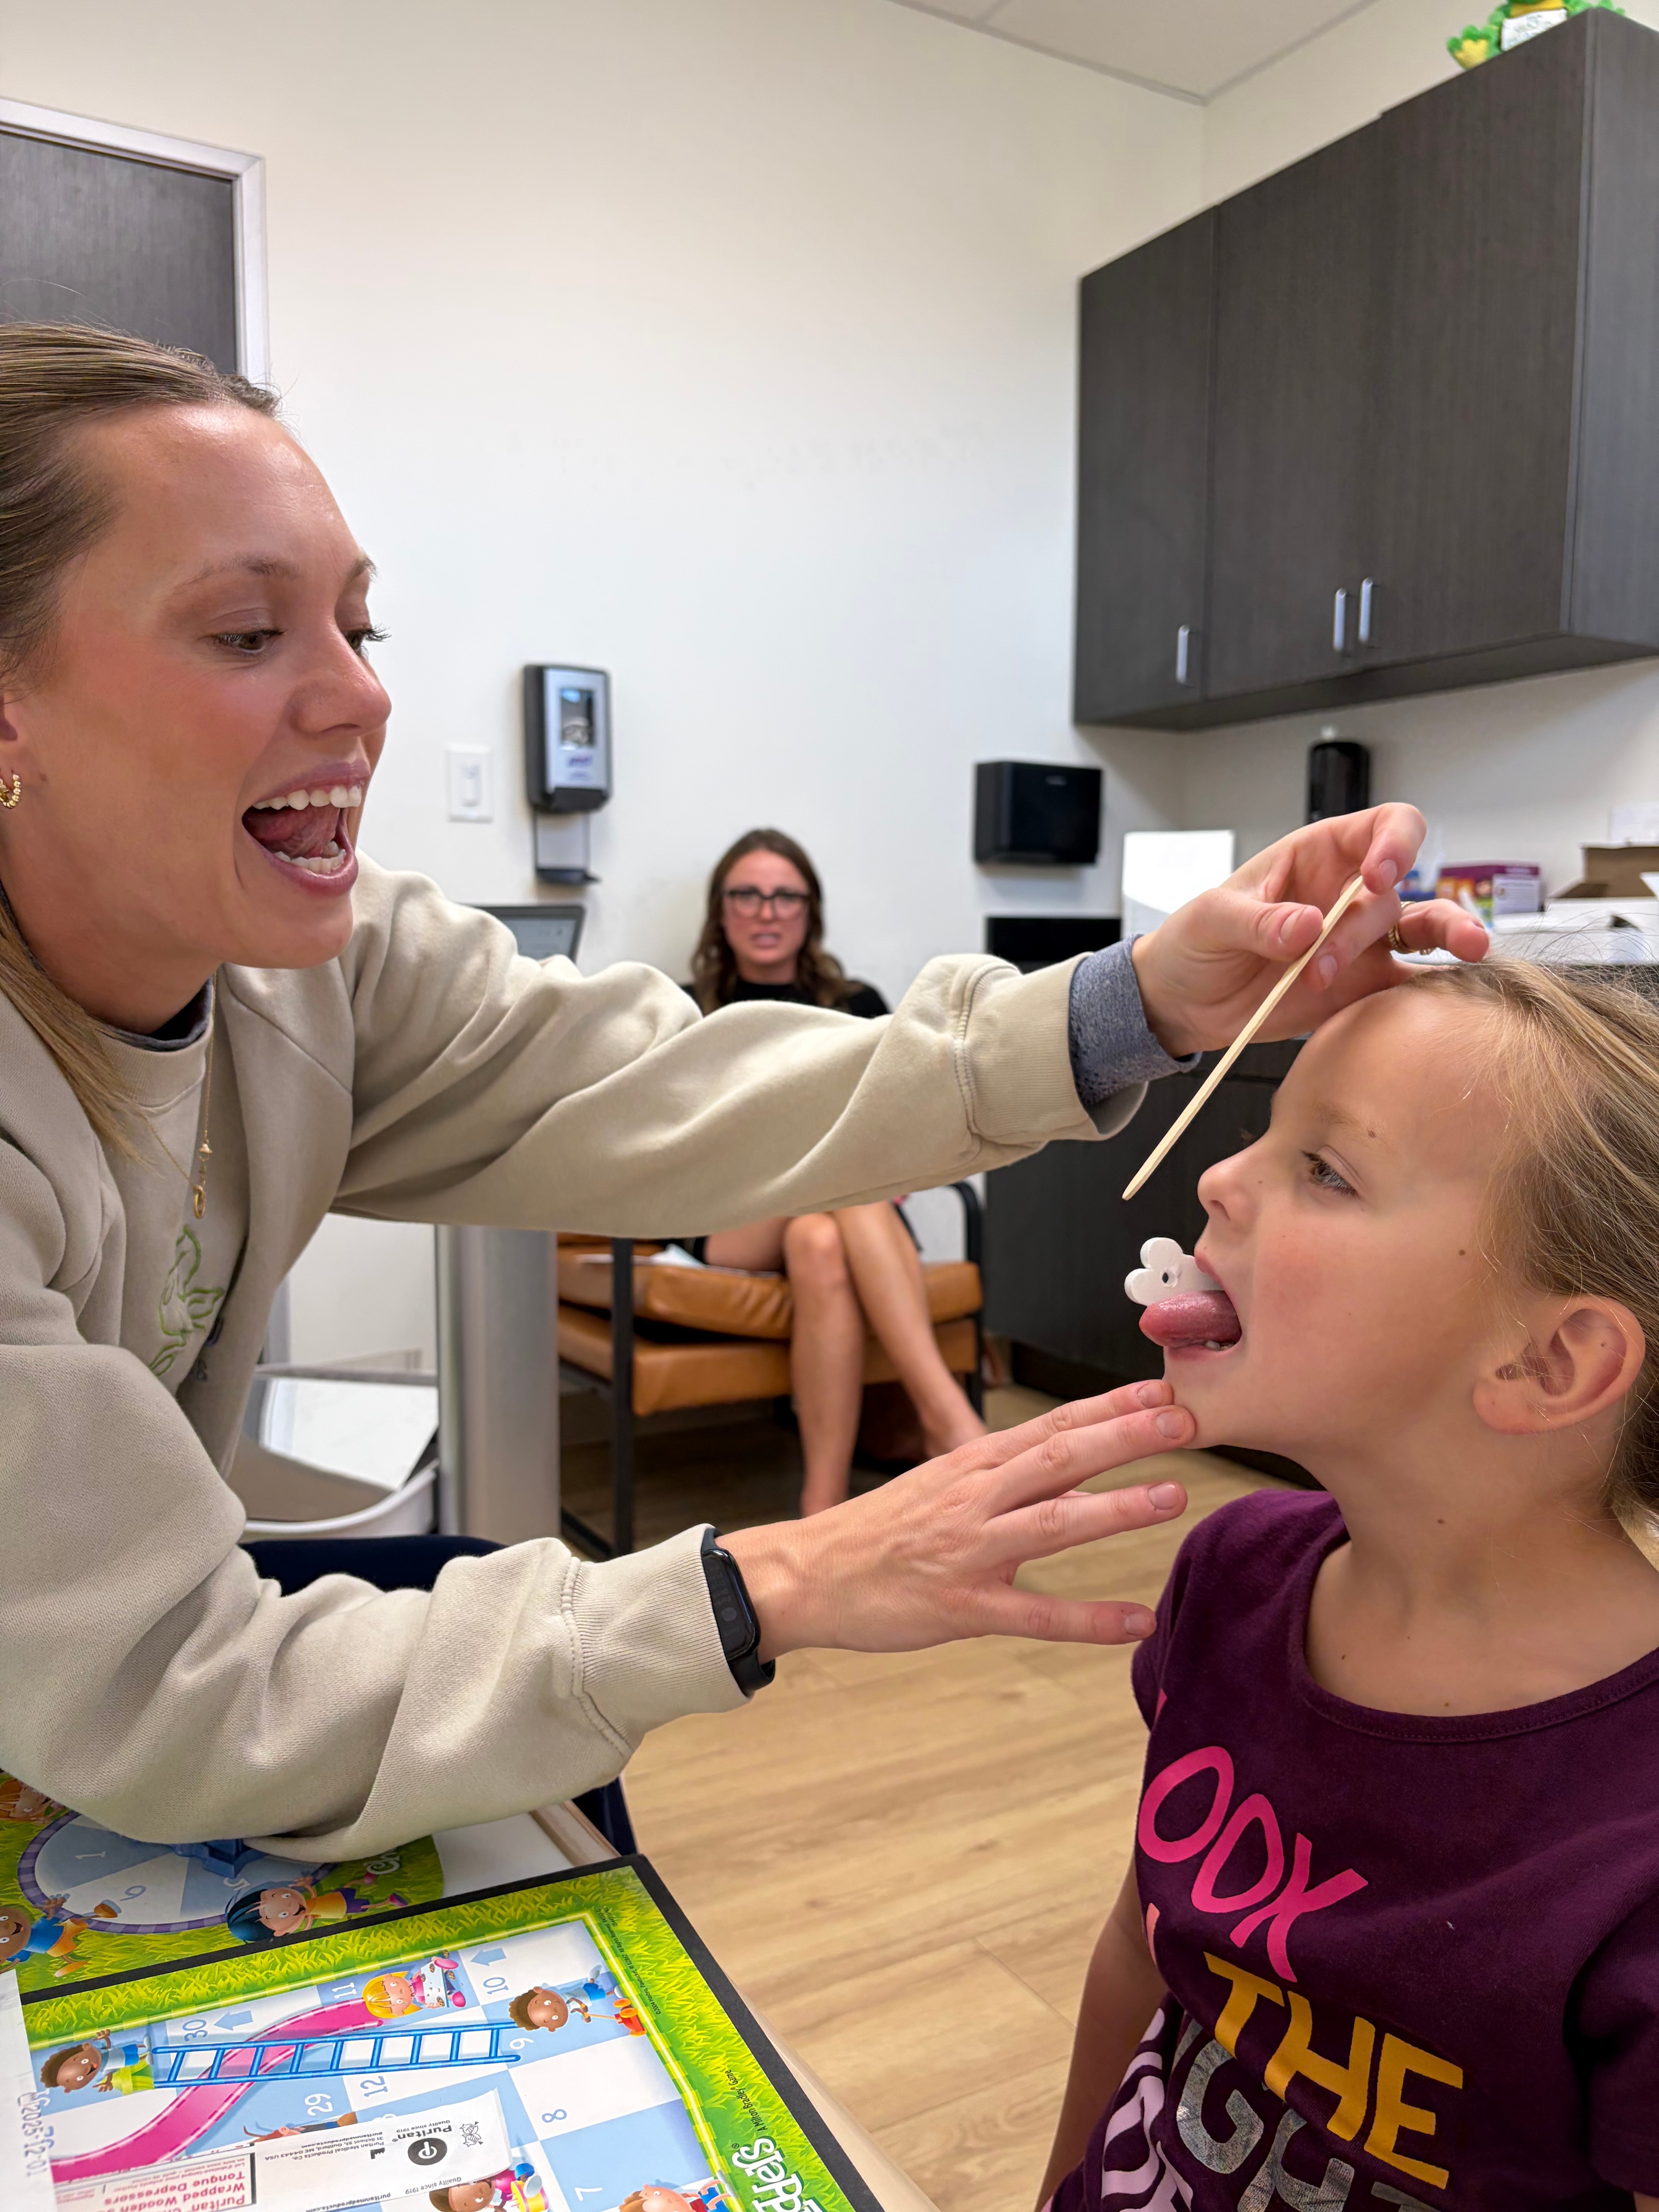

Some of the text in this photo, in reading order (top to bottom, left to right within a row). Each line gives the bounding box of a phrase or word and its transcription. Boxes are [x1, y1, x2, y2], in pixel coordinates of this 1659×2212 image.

[1137, 1746, 1368, 1982] OOK
[332, 1982, 357, 1999] 11
[483, 1977, 509, 1995] 10
[182, 2019, 208, 2042] 30
[724, 2069, 739, 2086] Game
[1204, 1952, 1463, 2189] THE
[360, 2076, 388, 2097] 12
[305, 2093, 333, 2116] 29
[542, 2109, 567, 2123] 8
[747, 2108, 764, 2127] Milton
[304, 2149, 333, 2159] Products
[192, 2171, 246, 2187] Tongue
[420, 2182, 437, 2190] since
[439, 2177, 462, 2186] Quality
[105, 2183, 187, 2206] Depressors
[183, 2183, 246, 2203] Wrapped
[574, 2187, 603, 2201] 7
[121, 2196, 177, 2212] Wooden
[191, 2194, 245, 2211] Puritan
